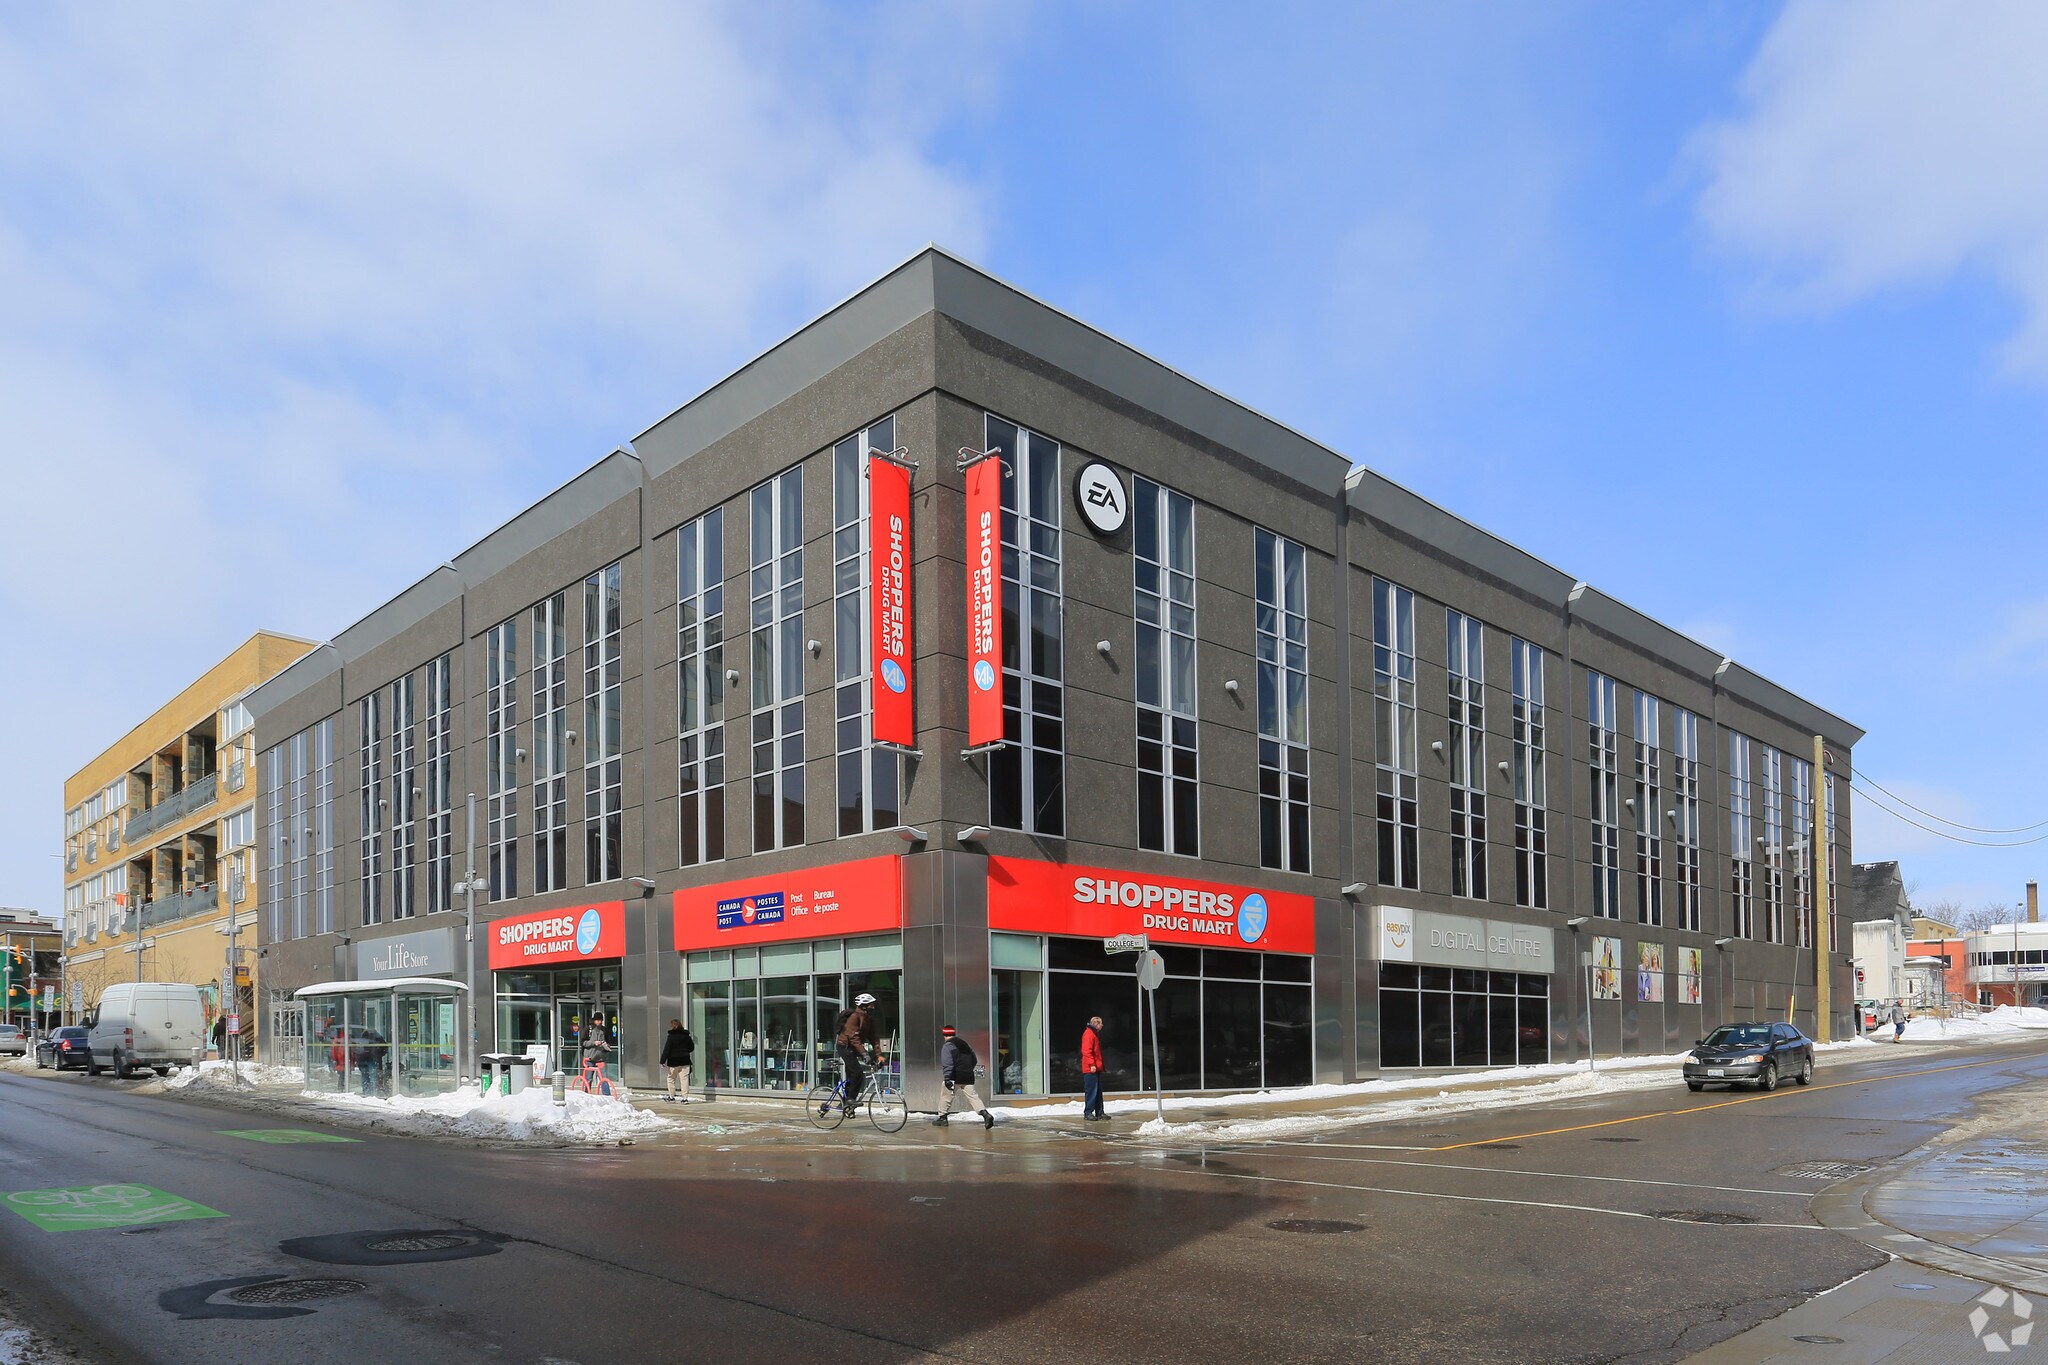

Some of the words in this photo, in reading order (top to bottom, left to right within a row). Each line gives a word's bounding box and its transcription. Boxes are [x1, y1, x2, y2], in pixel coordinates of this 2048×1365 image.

[1087, 481, 1120, 514] EA
[881, 566, 890, 609] DRUG
[890, 513, 903, 657] SHOPPERS
[980, 511, 992, 654] SHOPPERS
[882, 611, 891, 653] MART
[757, 897, 779, 906] POSTES
[790, 893, 803, 904] Post
[813, 890, 834, 900] Bureau
[1073, 876, 1235, 917] SHOPPERS
[719, 902, 741, 912] CANADA
[790, 905, 809, 917] Office
[813, 903, 822, 914] de
[821, 902, 839, 915] poste
[719, 917, 732, 926] POST
[757, 911, 781, 921] CANADA
[499, 916, 574, 945] SHOPPERS
[1143, 914, 1189, 931] DRUG
[1192, 918, 1234, 936] MART
[1386, 921, 1411, 935] easypix
[524, 942, 547, 955] DRUG
[547, 939, 574, 953] MART
[1107, 940, 1135, 948] COLLEGE
[1431, 929, 1485, 952] DIGITAL
[1488, 935, 1541, 958] CENTRE
[373, 957, 387, 971] Your
[387, 942, 410, 970] Life
[410, 952, 429, 968] Store
